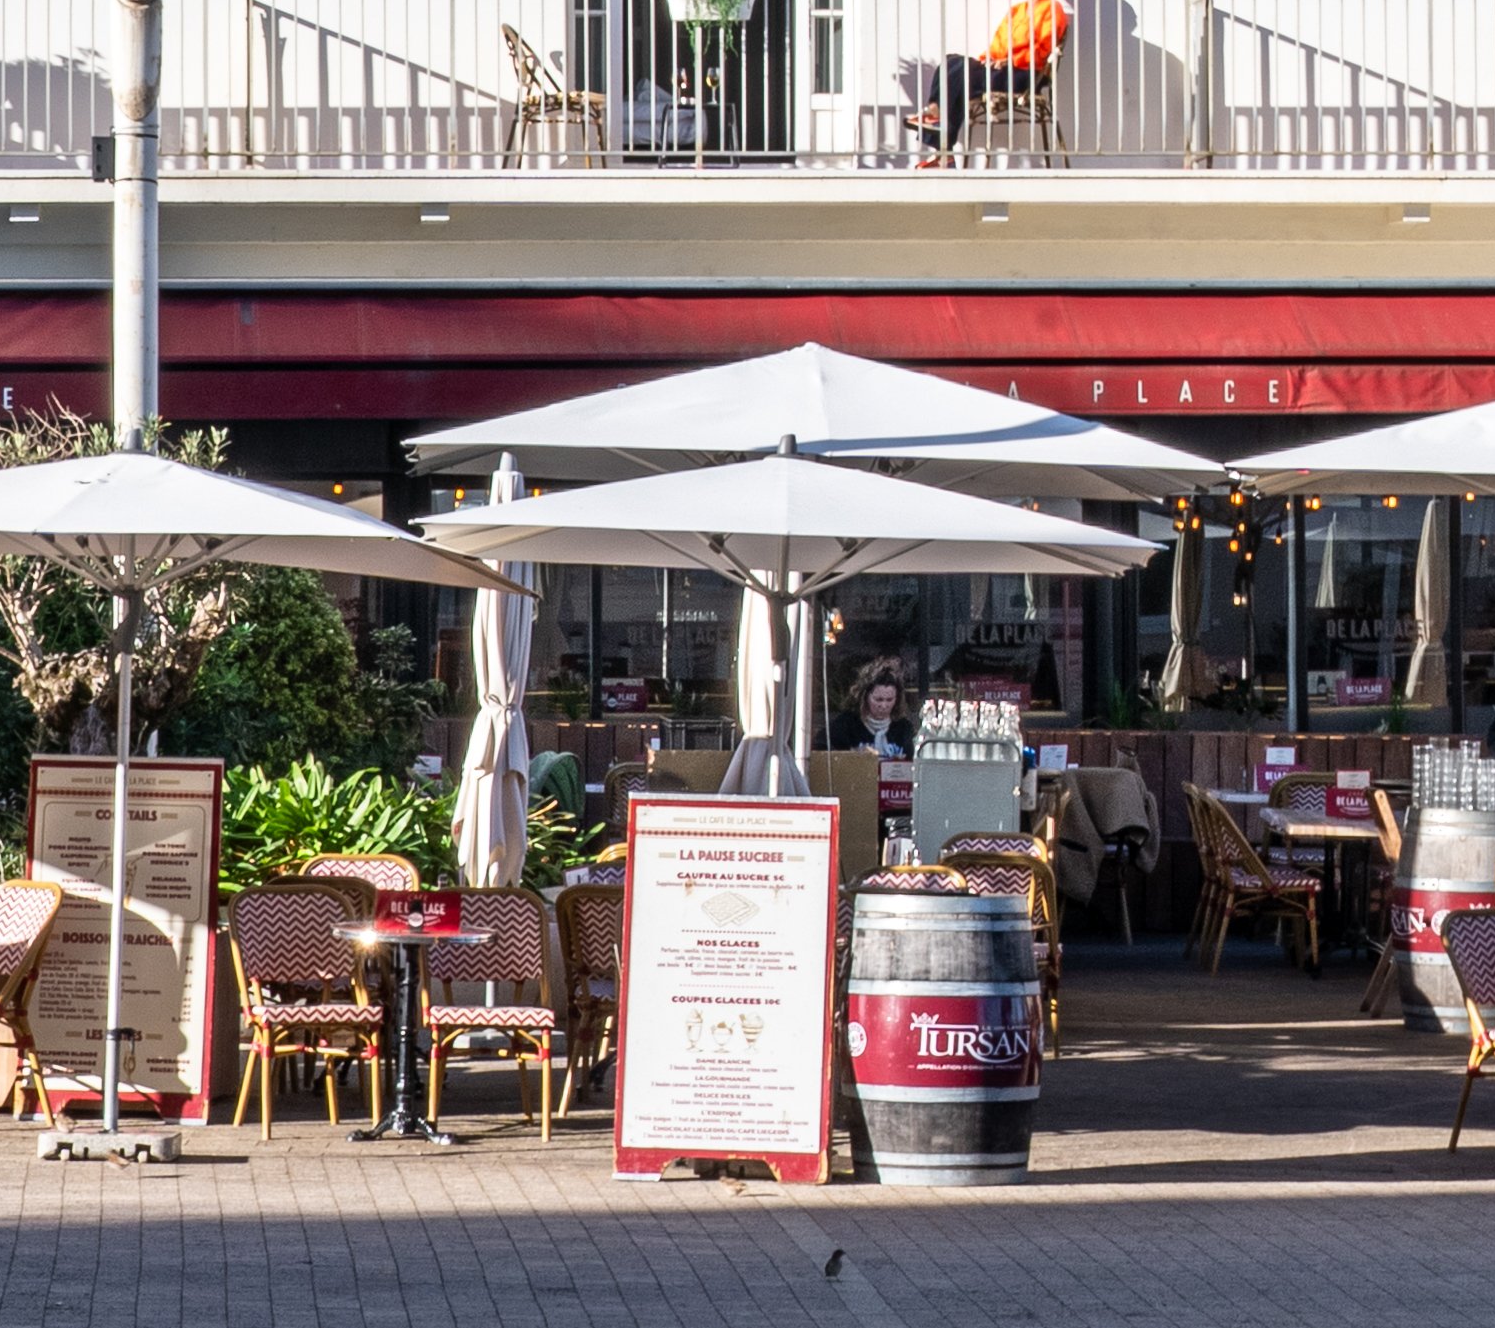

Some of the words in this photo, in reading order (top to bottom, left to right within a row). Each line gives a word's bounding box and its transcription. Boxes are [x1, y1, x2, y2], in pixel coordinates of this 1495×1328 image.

[1093, 379, 1280, 404] PLACE
[1326, 620, 1347, 638] DE
[1351, 620, 1371, 638] LA
[1357, 686, 1364, 694] LA
[1365, 685, 1383, 694] PLACE
[890, 790, 900, 799] LA
[1336, 797, 1345, 806] DE
[1346, 797, 1355, 806] LA
[699, 816, 707, 824] LE
[737, 817, 745, 825] LA
[680, 850, 695, 861] LA
[698, 850, 735, 862] PAUSE
[738, 851, 784, 863] SUCREE
[677, 872, 717, 880] GAUFRE
[720, 872, 734, 880] AU
[736, 873, 770, 881] SUCRE
[390, 901, 403, 914] DE
[422, 902, 446, 915] LACE
[697, 939, 717, 947] NOS
[720, 940, 760, 948] GLACES
[672, 995, 712, 1004] COUPES
[715, 996, 762, 1005] GLACEES
[86, 1030, 103, 1040] LES
[910, 1023, 1031, 1062] TURSAN
[916, 1063, 961, 1071] APPELLATION
